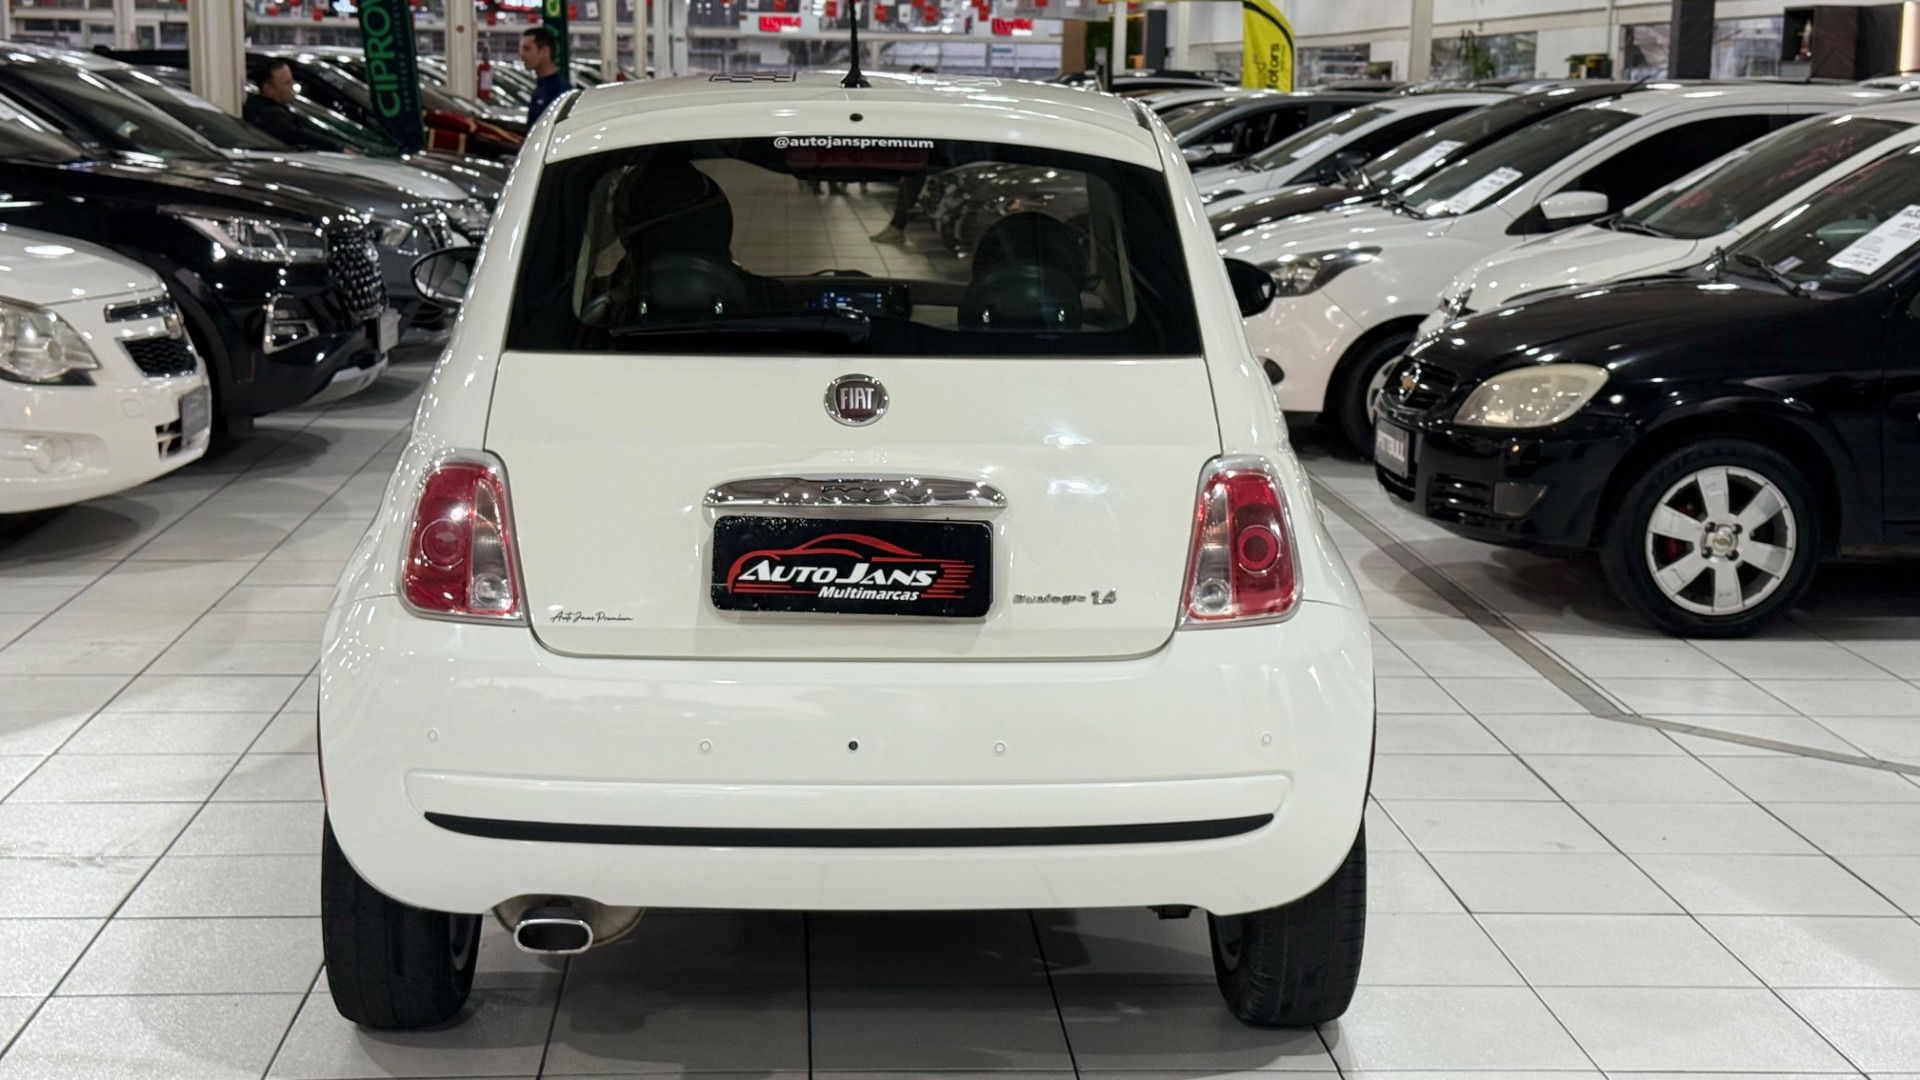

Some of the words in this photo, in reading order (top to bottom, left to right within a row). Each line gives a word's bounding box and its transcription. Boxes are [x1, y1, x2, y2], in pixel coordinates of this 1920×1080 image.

[773, 136, 934, 149] @autojanspremium
[840, 387, 875, 410] FIAT
[818, 585, 920, 601] Multimarcas
[596, 611, 635, 624] Premium
